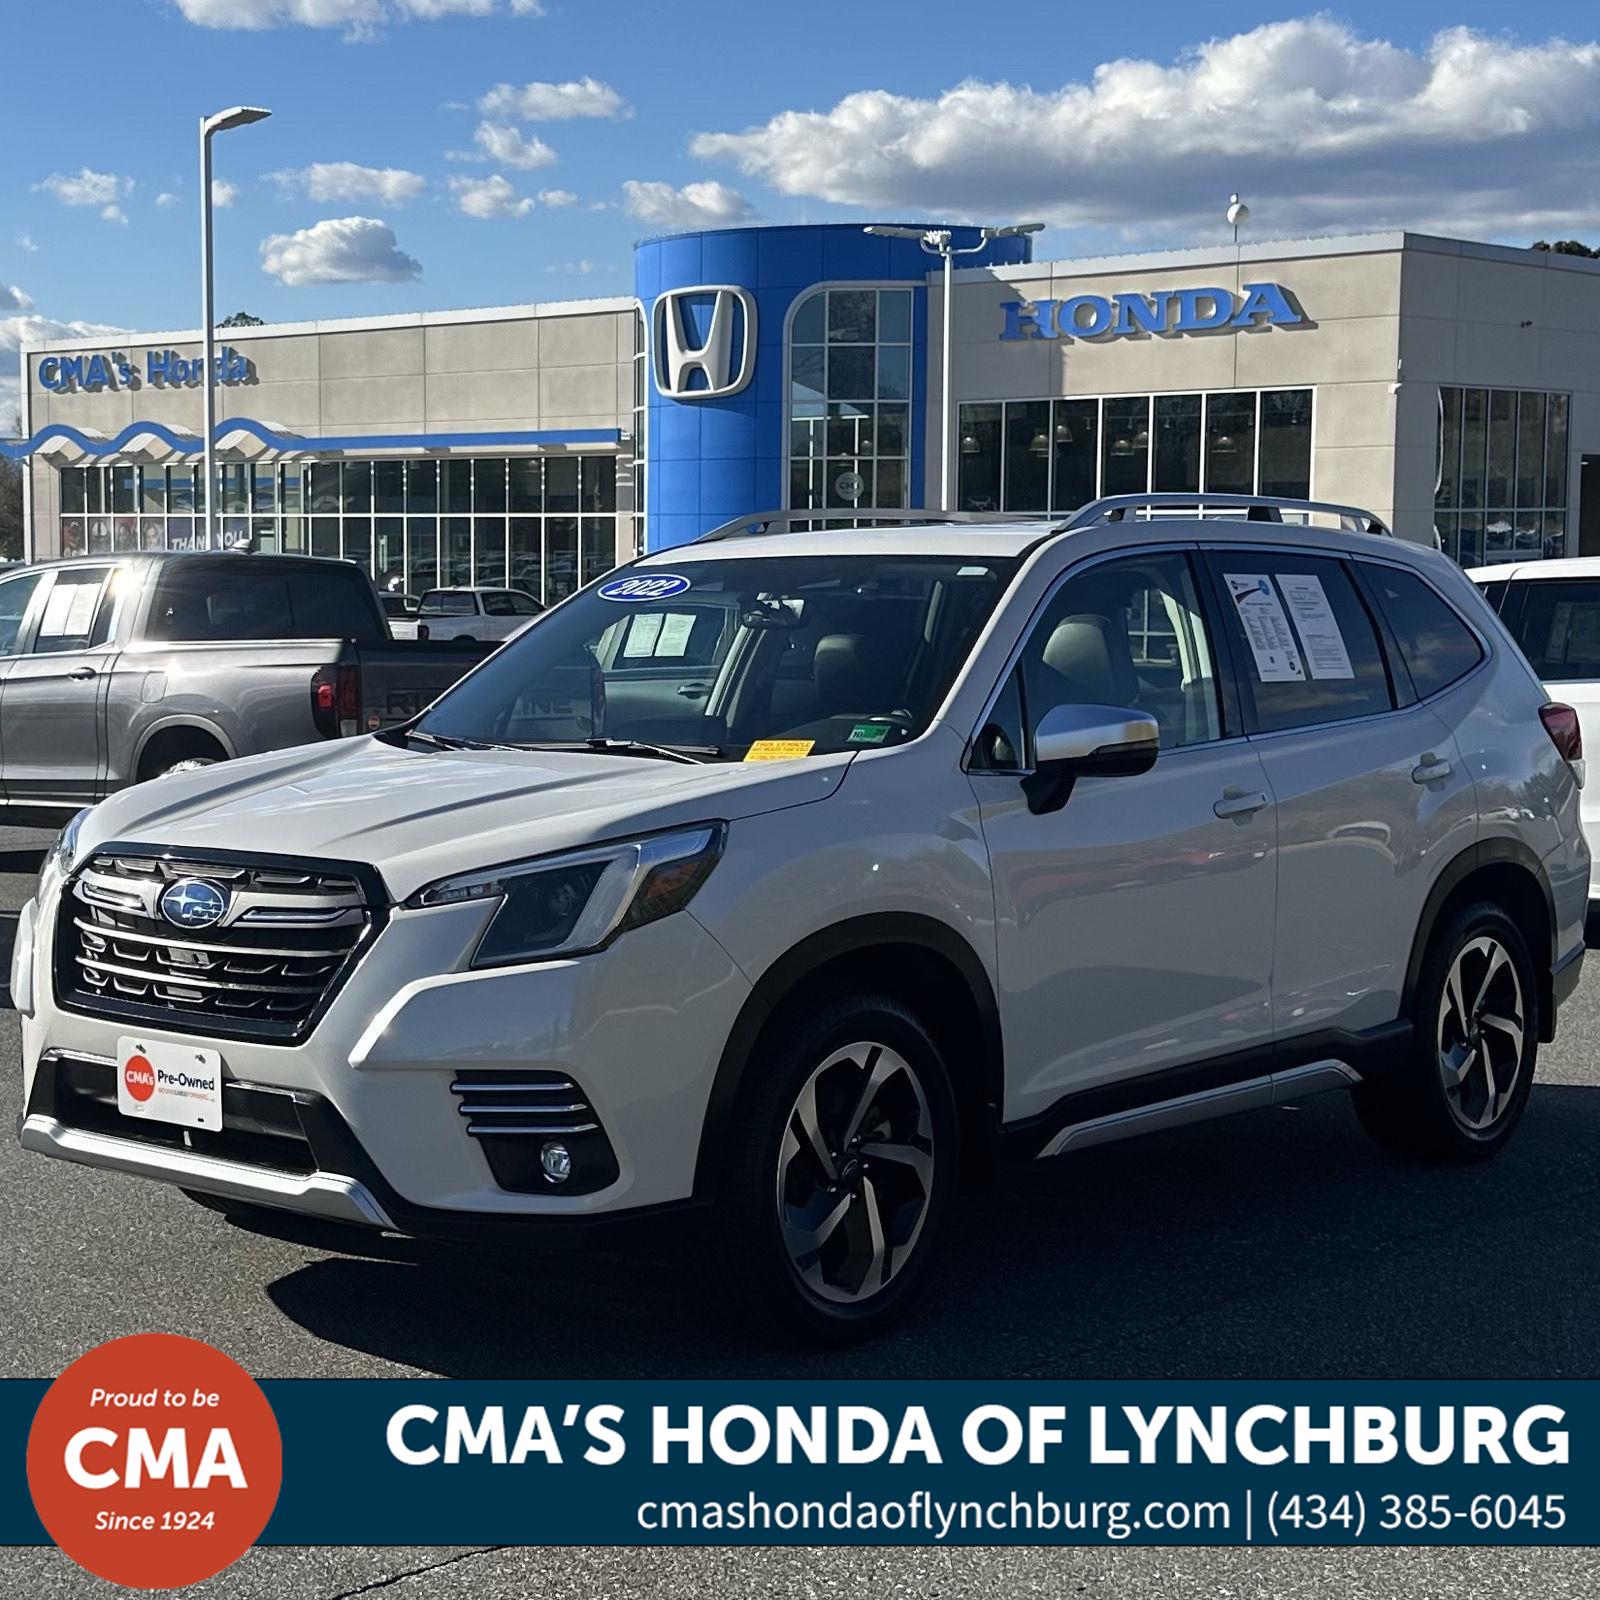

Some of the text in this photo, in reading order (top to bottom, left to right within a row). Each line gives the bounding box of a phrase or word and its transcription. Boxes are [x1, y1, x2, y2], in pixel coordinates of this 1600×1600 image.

[1000, 283, 1301, 341] HONDA
[39, 347, 247, 390] CMA's Honda
[605, 580, 681, 596] 2022
[126, 1070, 154, 1085] CMA's
[157, 1069, 215, 1091] Pre-Owned
